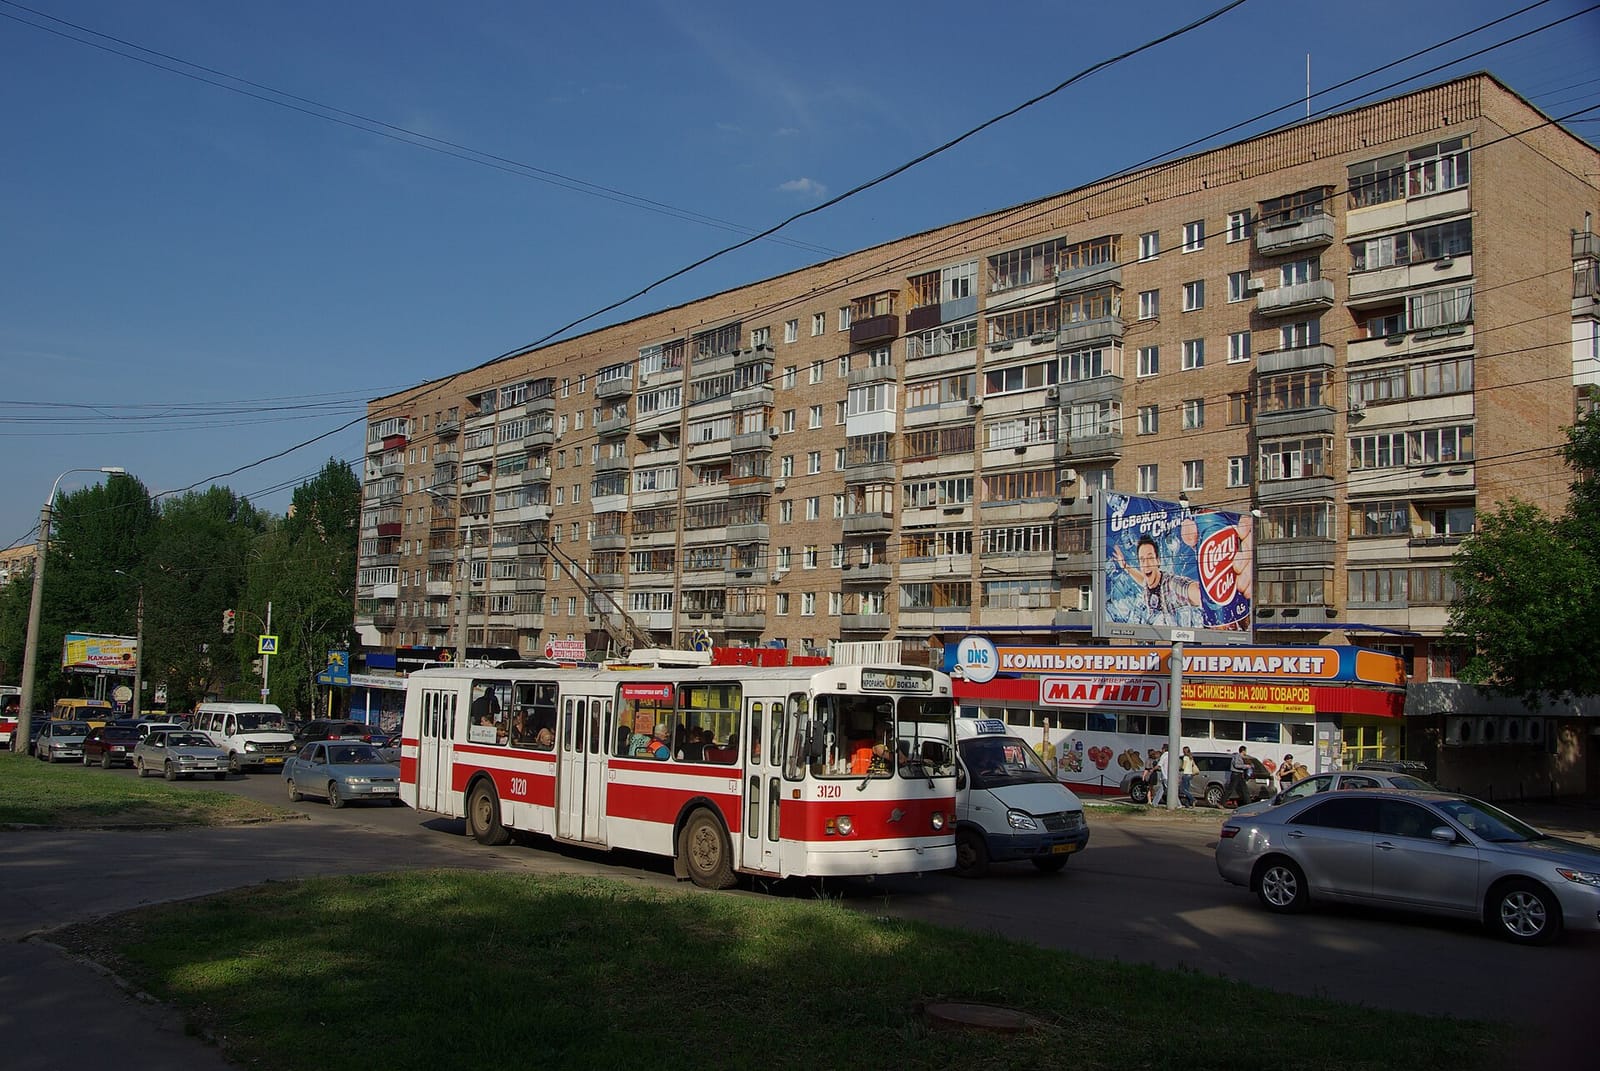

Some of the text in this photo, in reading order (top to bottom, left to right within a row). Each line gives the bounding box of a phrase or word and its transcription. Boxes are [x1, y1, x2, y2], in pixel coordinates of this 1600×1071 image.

[1203, 534, 1235, 579] Crazy
[967, 649, 988, 664] DNS
[1002, 653, 1325, 674] КОМПЬЮТЕРНЫЙ УПЕРМАРКЕТ
[1048, 684, 1156, 702] МАГНИТ
[1181, 686, 1310, 702] ЕНЫ СНИЖЕНЫ НА 2000 ТОВАРОВ
[510, 777, 527, 796] 3120
[816, 785, 842, 799] 3120
